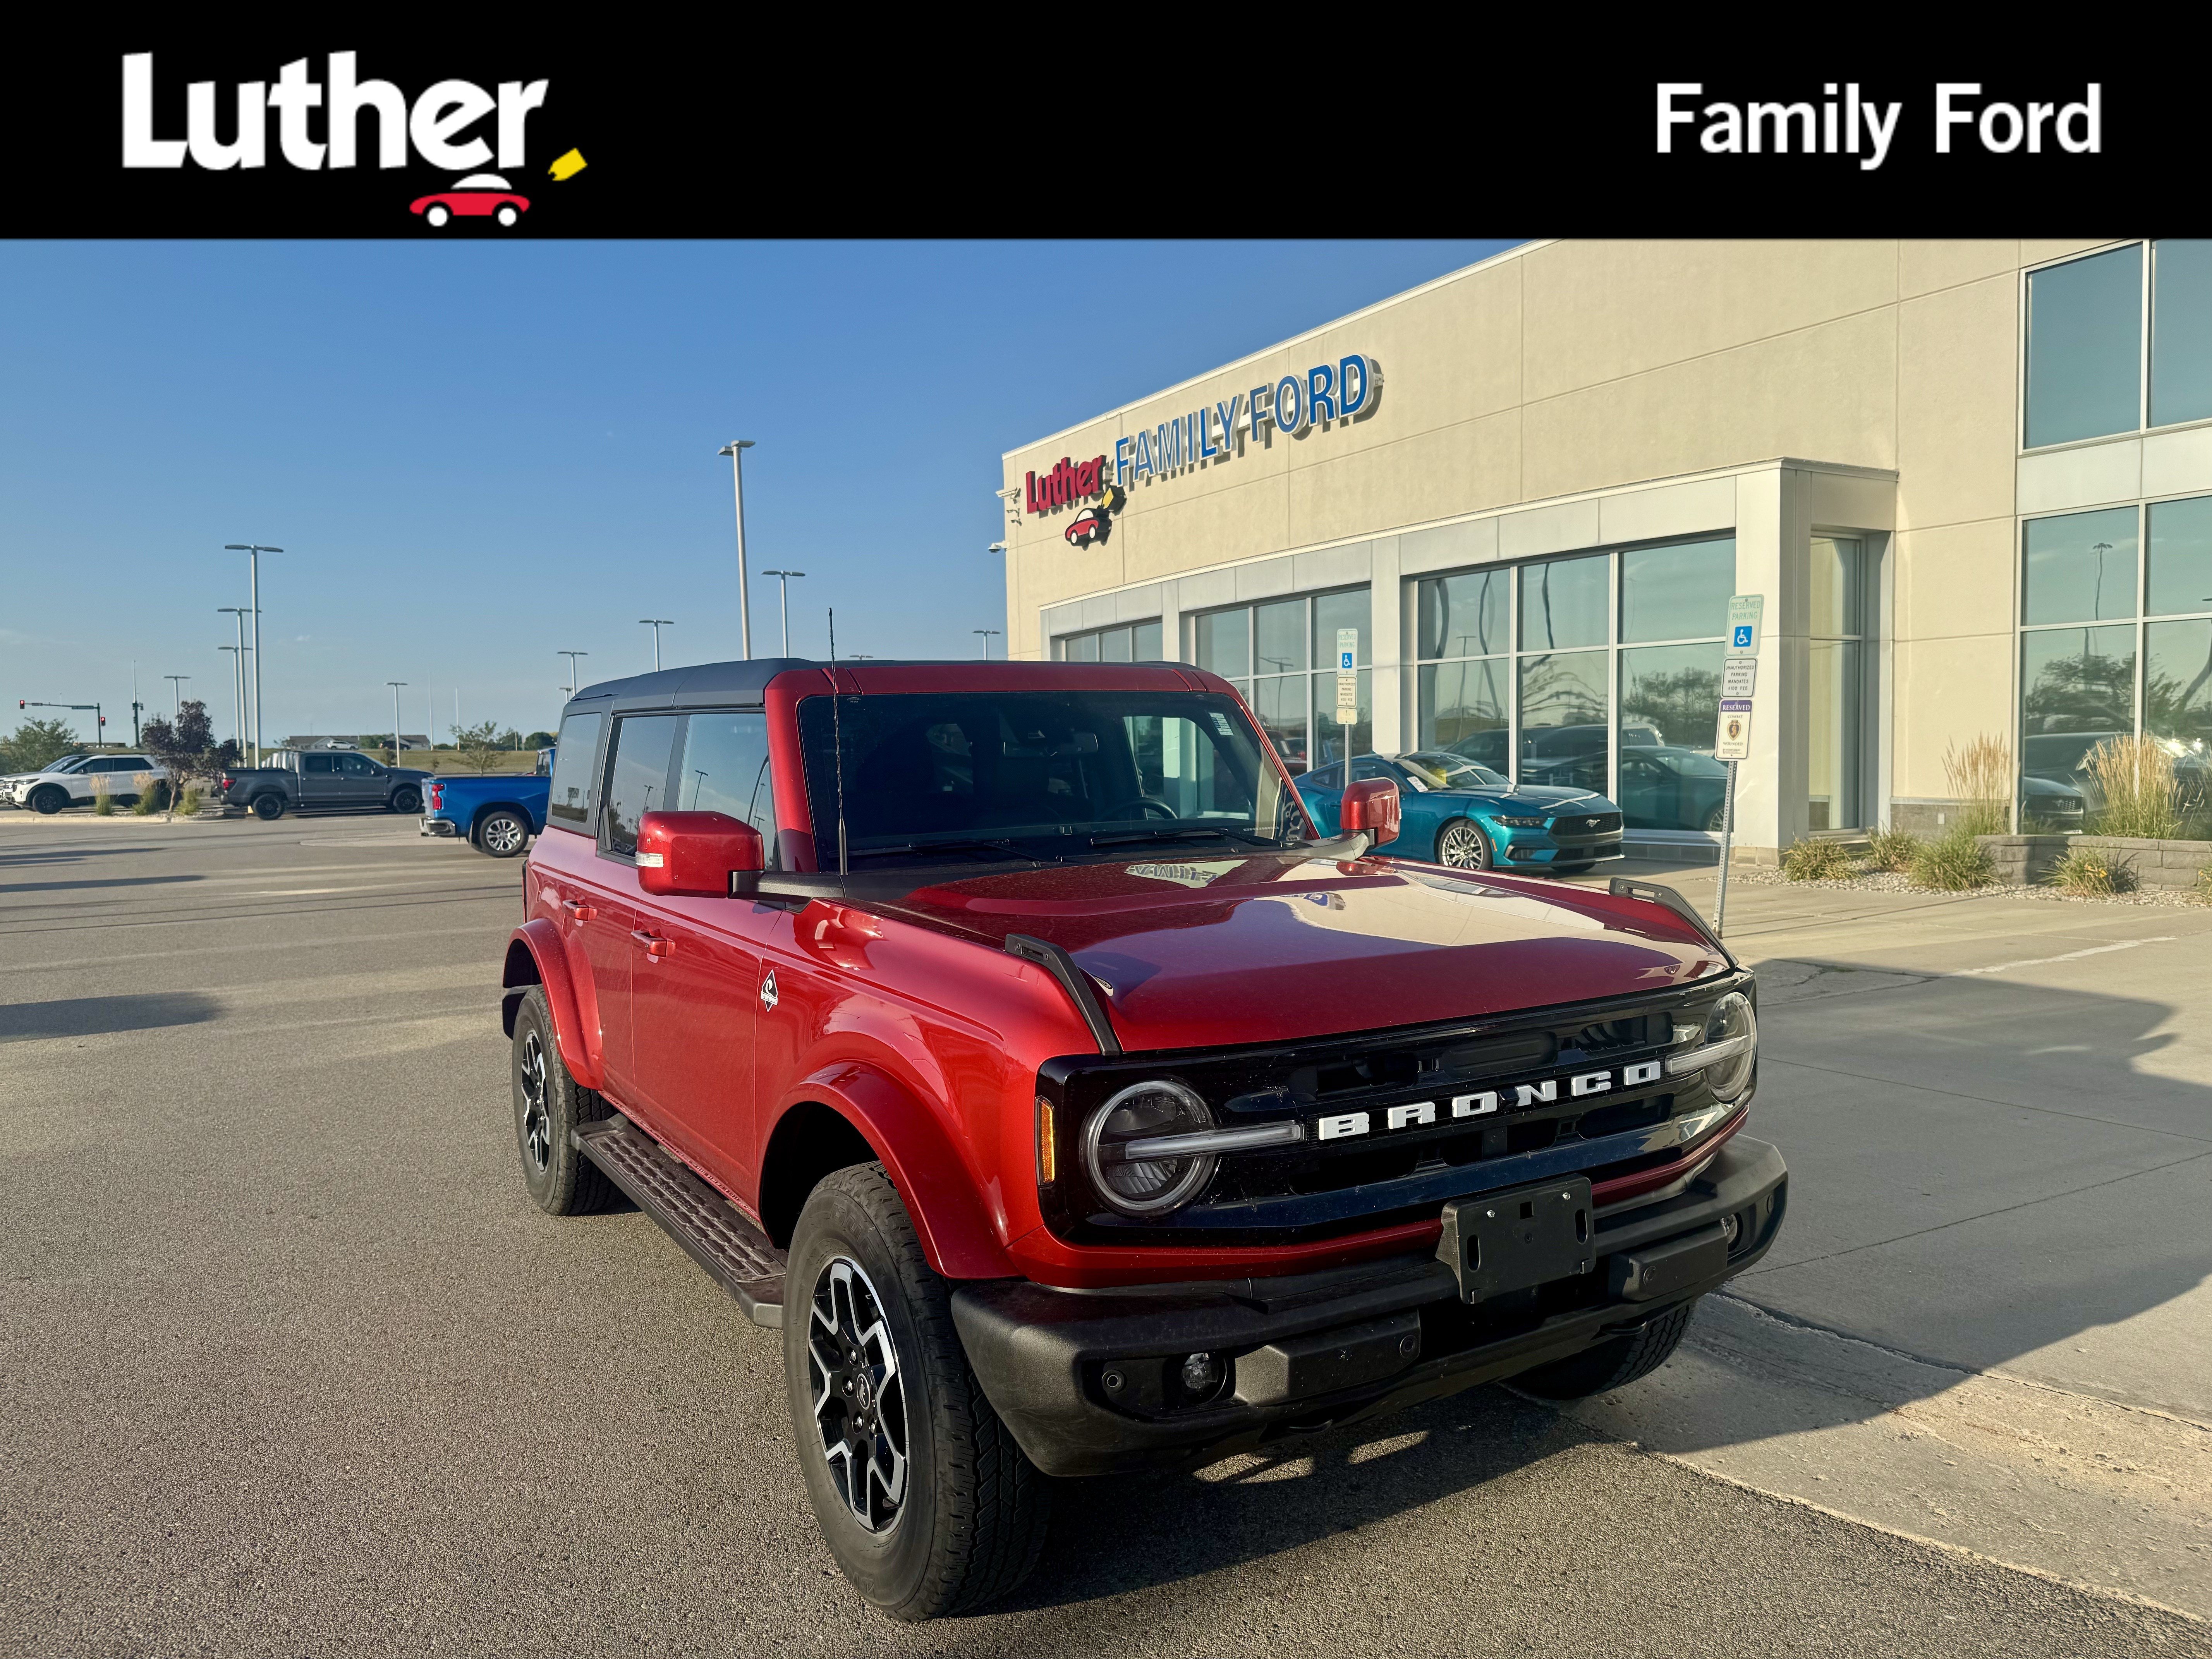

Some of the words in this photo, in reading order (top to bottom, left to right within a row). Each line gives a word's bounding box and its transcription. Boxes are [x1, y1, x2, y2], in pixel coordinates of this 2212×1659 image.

[1115, 394, 1241, 486] FAMILY
[1250, 354, 1374, 442] FORD
[1026, 455, 1105, 514] Luther
[1731, 601, 1760, 610] RESERVED
[1732, 611, 1757, 620] PARKING
[1318, 1061, 1661, 1140] BRONCO
